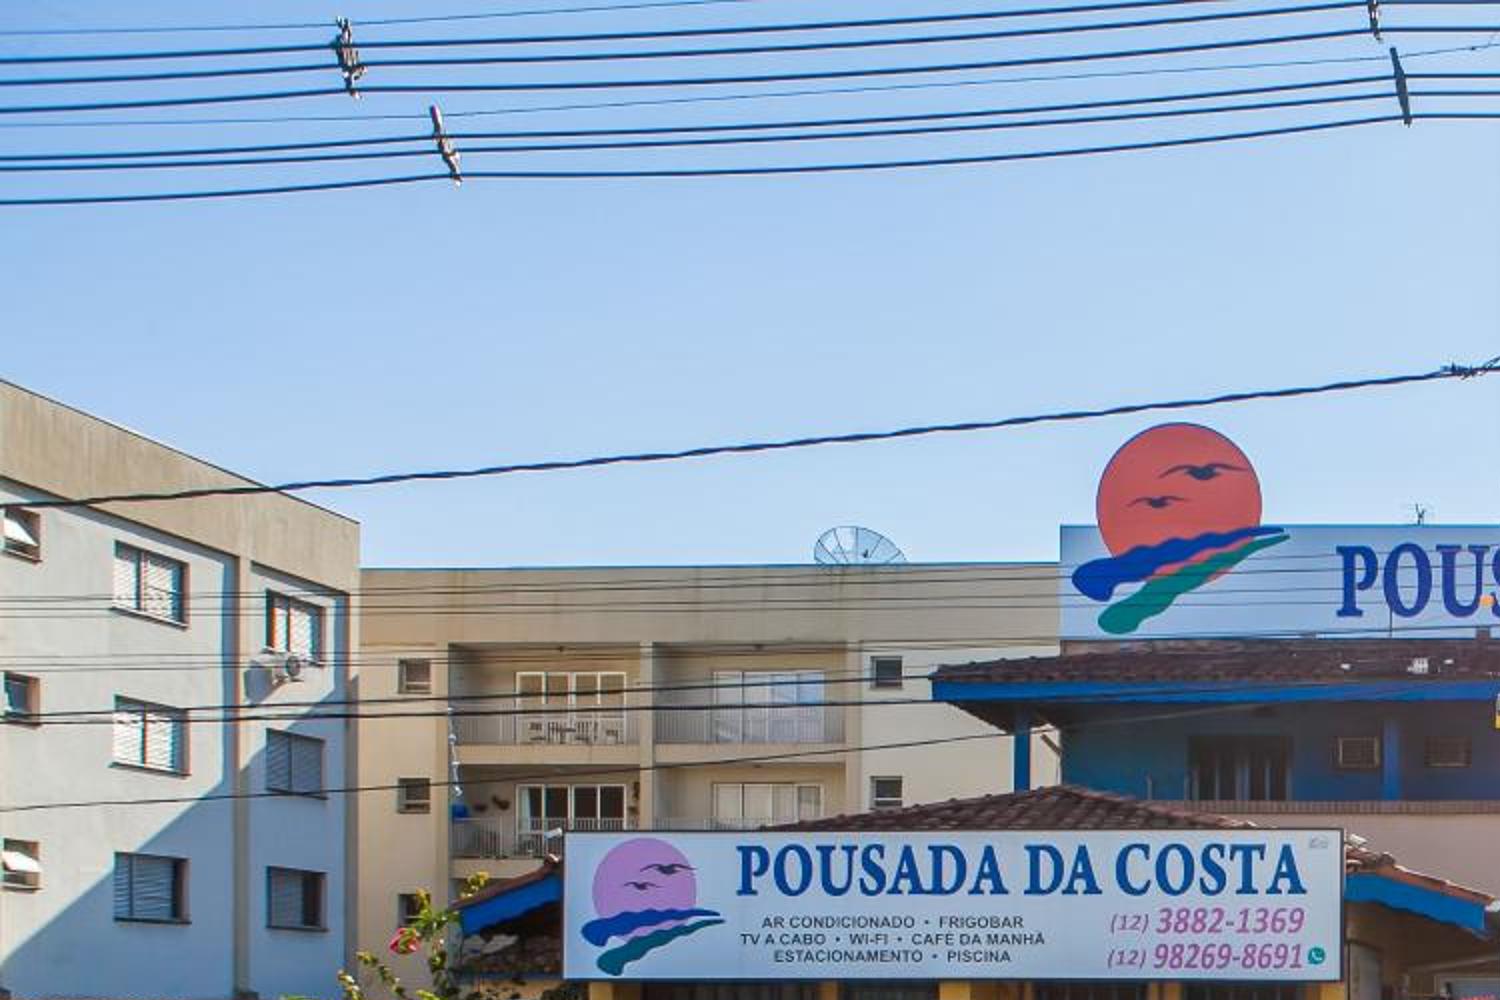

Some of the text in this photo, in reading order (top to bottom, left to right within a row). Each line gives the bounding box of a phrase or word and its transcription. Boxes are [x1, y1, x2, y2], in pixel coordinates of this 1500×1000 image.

[736, 843, 1308, 896] POUSADA DA COSTA
[761, 916, 1024, 929] AR CONDICIONADO FRIGOBAR
[1110, 907, 1305, 934] (12) 3882-1369
[740, 933, 761, 945] TV
[764, 933, 776, 945] A
[779, 933, 827, 945] CABO
[849, 933, 889, 945] WI-FI
[959, 933, 982, 945] DA
[773, 950, 1012, 963] ESTACIONAMENTO PISCINA
[1107, 943, 1304, 969] (12) 98269-8691
